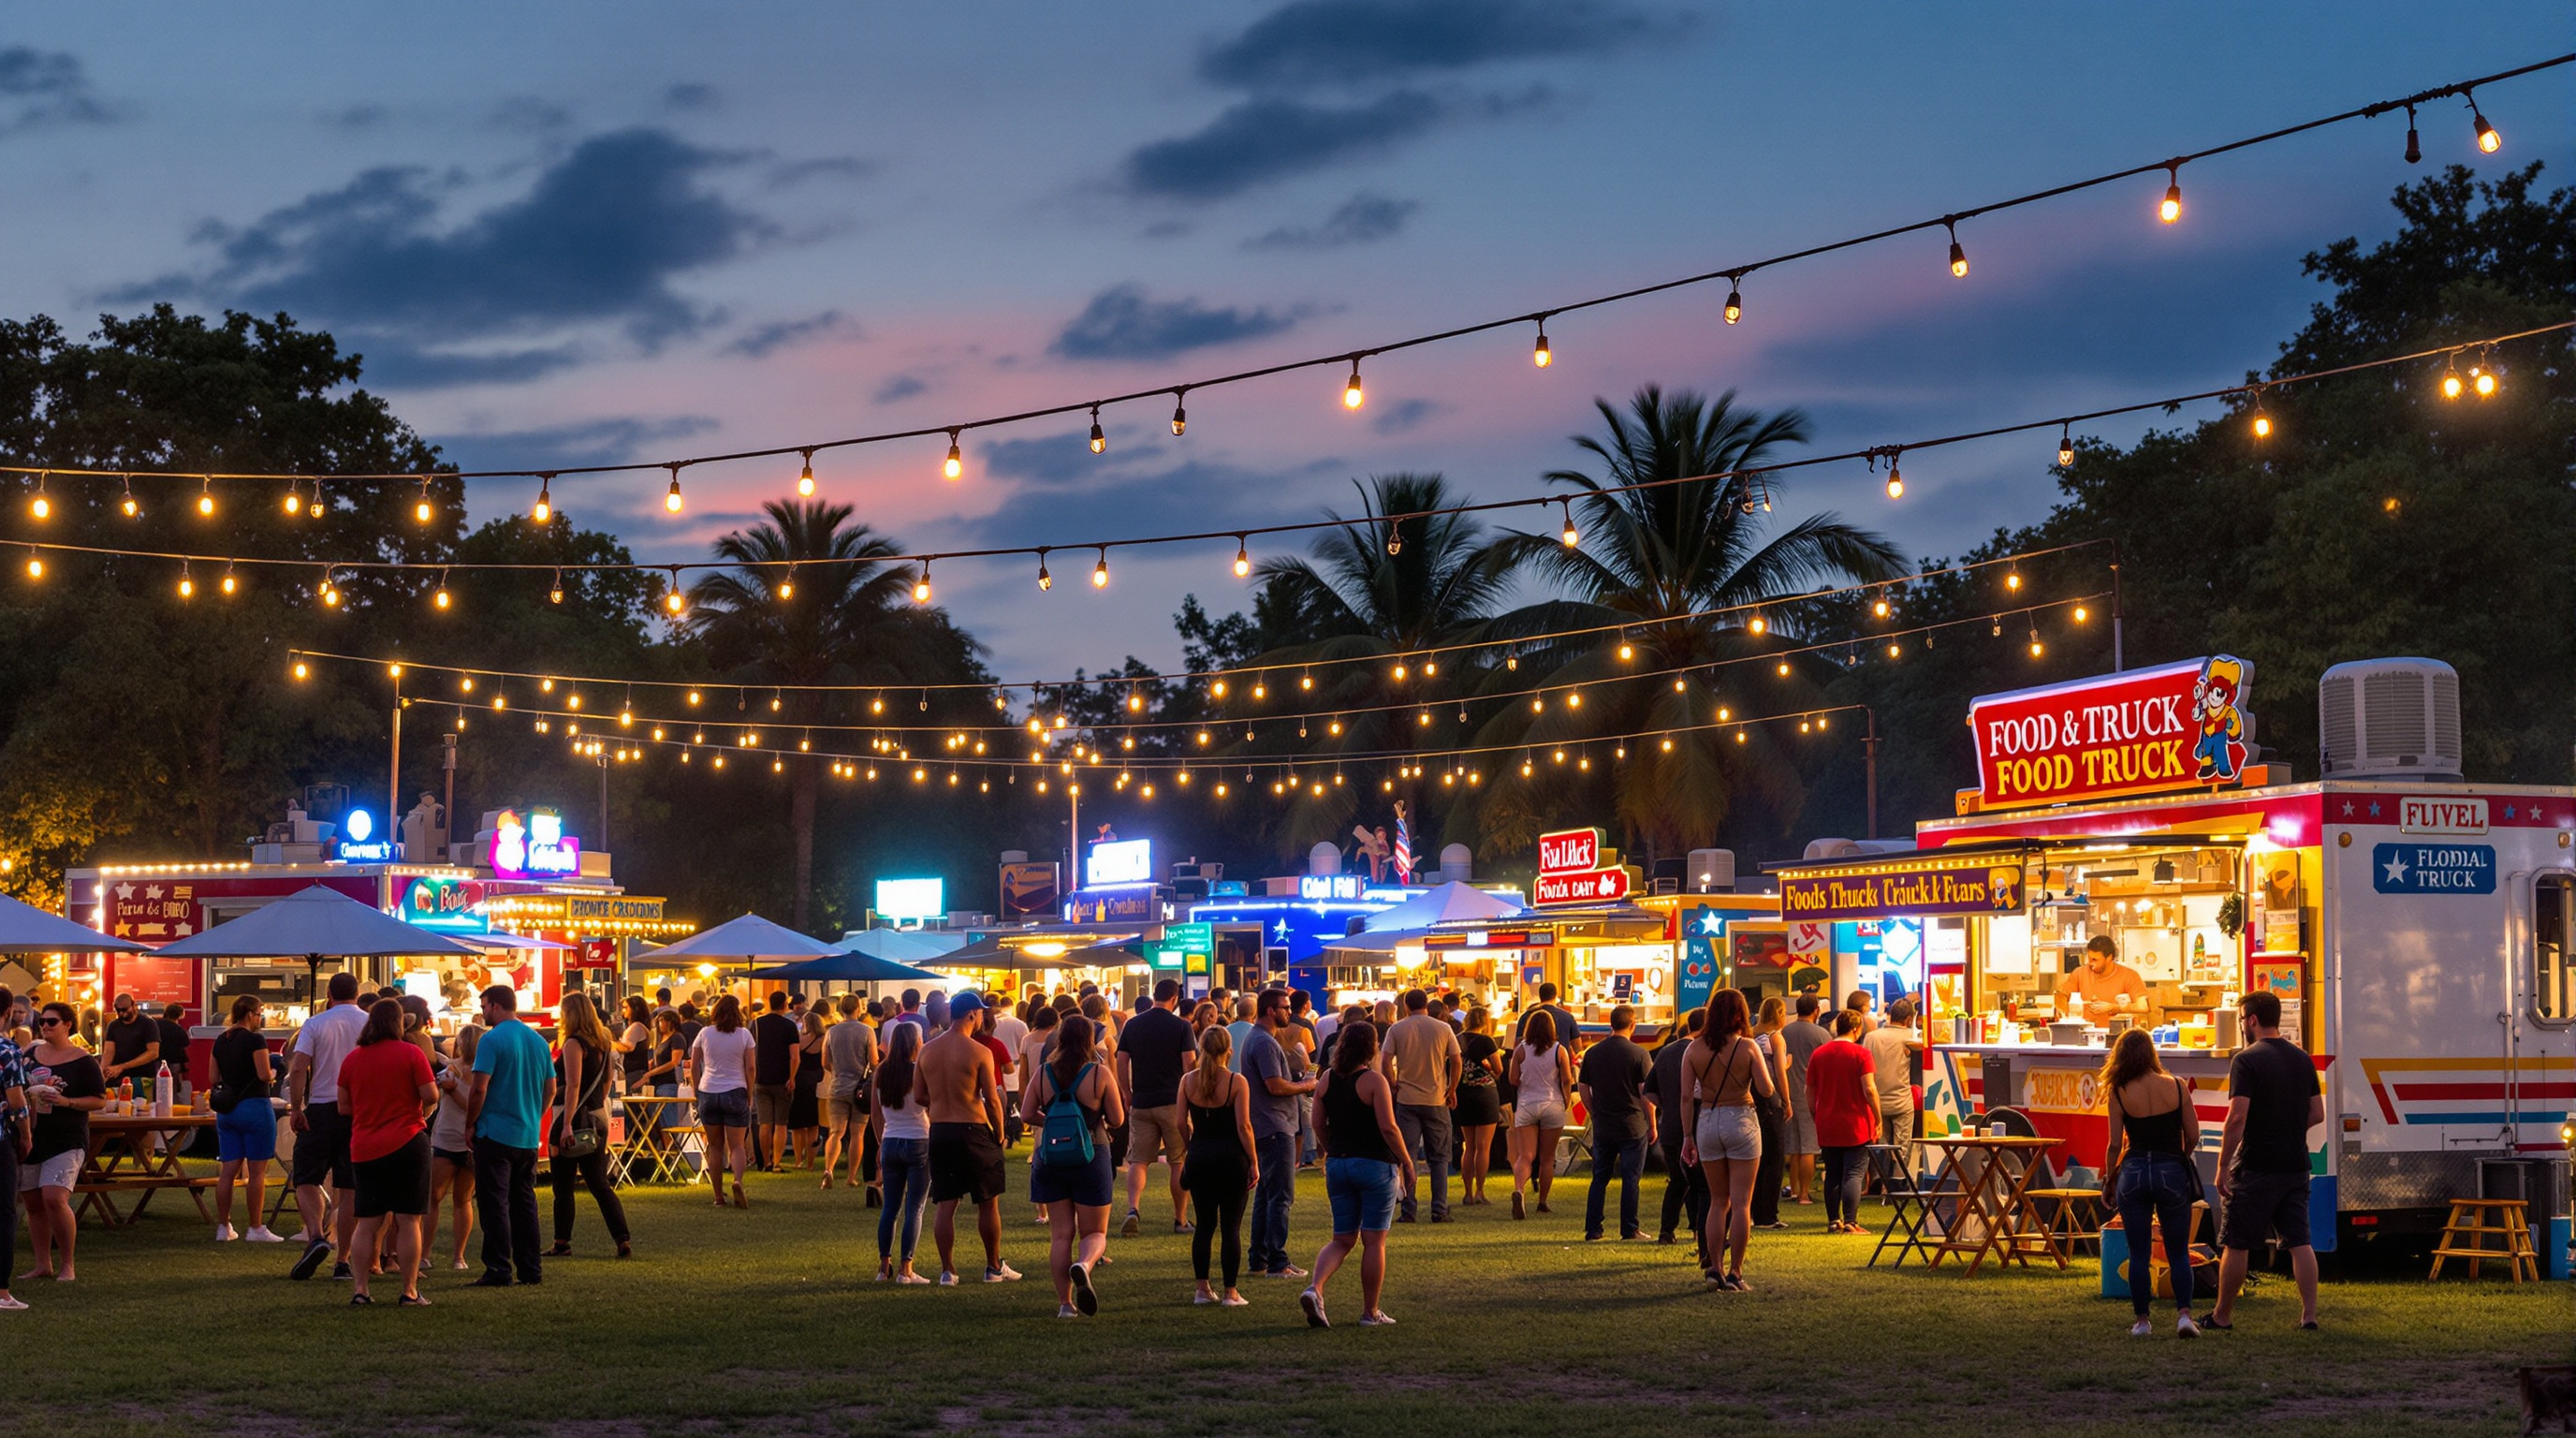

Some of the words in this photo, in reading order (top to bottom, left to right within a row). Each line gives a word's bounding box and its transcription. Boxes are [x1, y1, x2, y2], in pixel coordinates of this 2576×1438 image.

[1989, 713, 2057, 757] FOOD
[2061, 710, 2081, 747] &
[2083, 695, 2185, 743] TRUCK
[1996, 754, 2074, 796] FOOD
[2082, 739, 2186, 786] TRUCK
[1786, 885, 1827, 911] Foods
[2416, 871, 2477, 888] TRUCK
